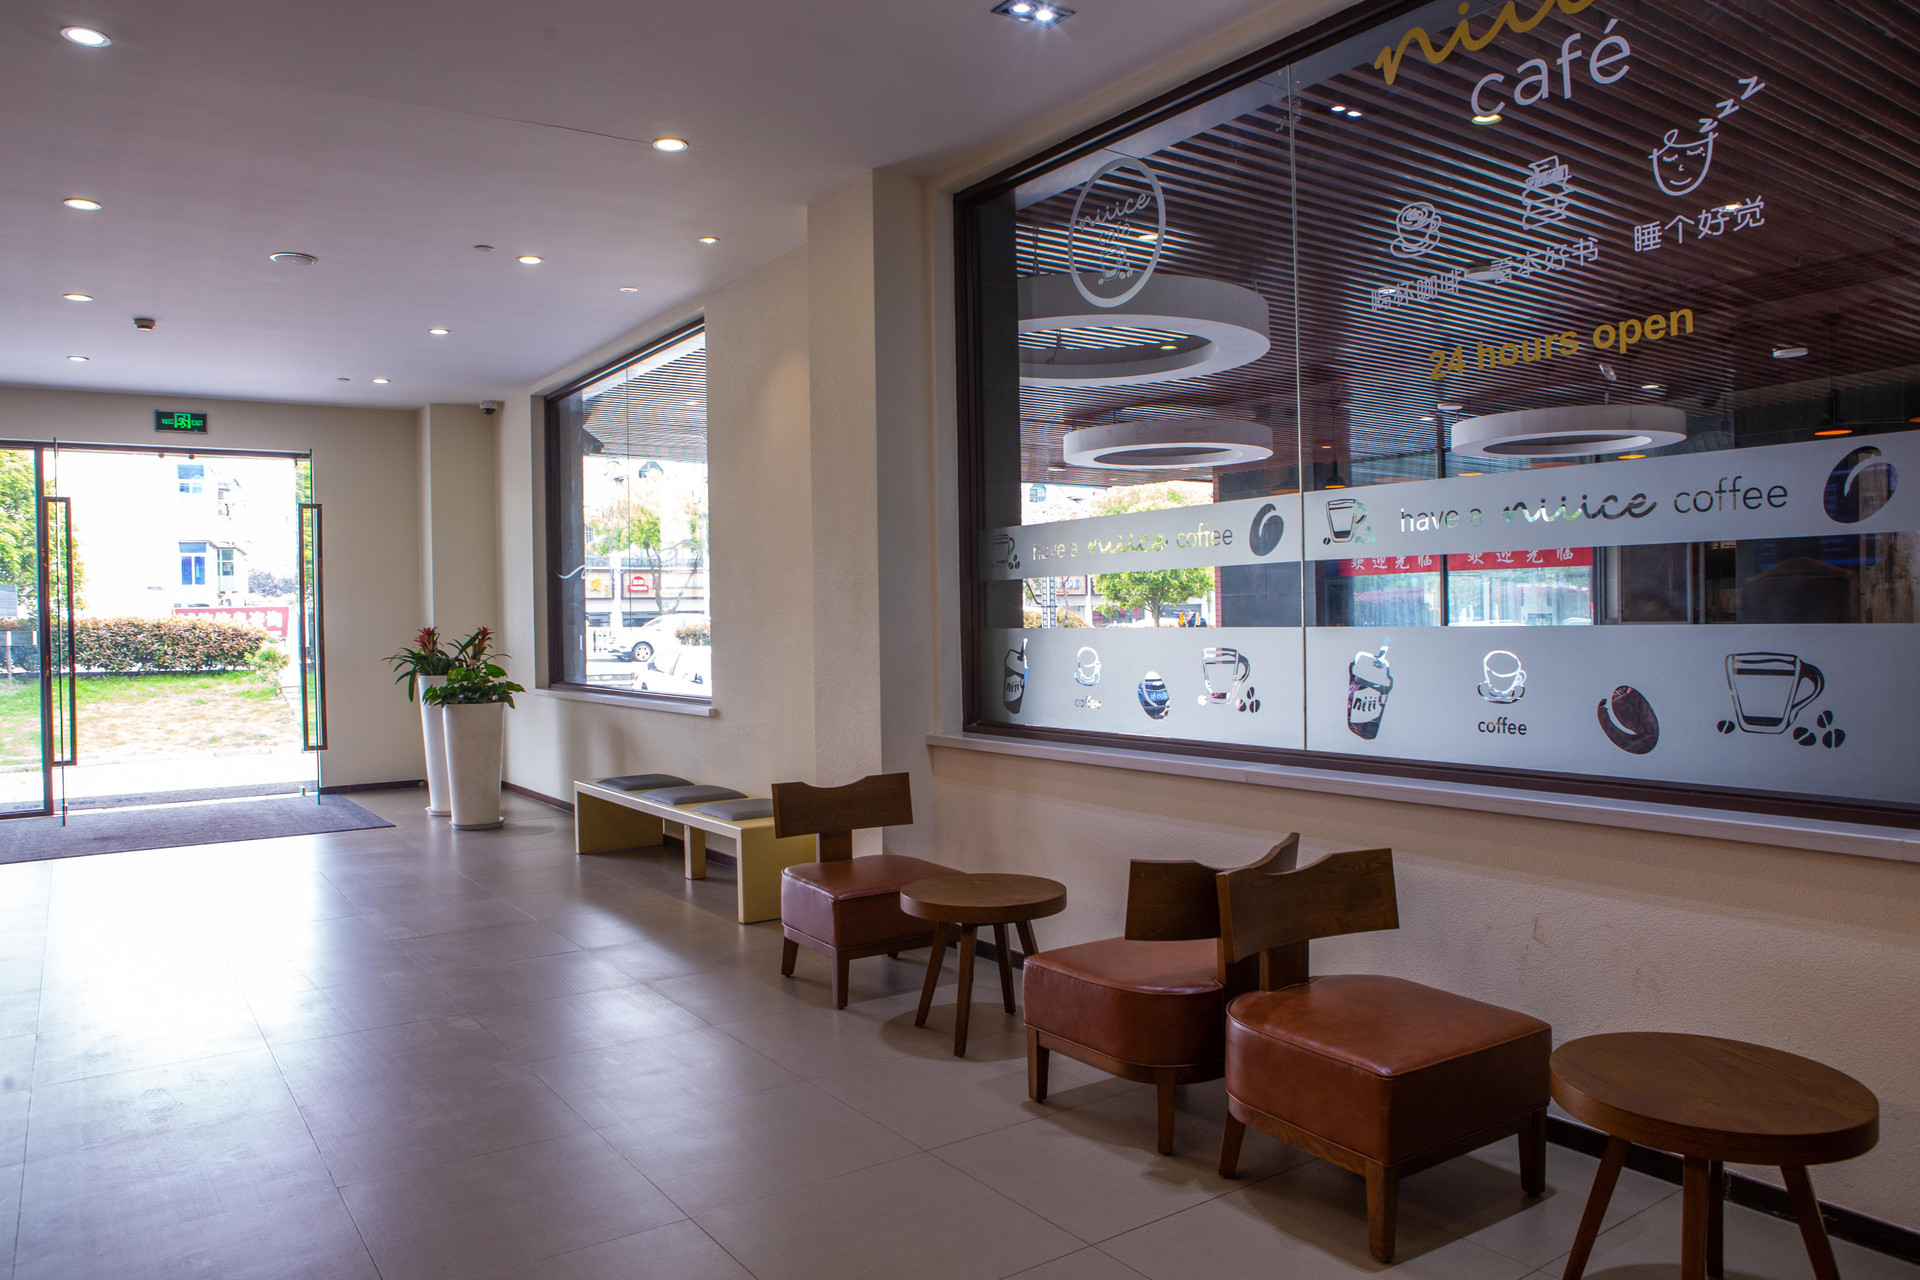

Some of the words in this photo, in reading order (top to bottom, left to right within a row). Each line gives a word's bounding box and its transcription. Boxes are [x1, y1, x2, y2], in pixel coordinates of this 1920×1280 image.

[1470, 18, 1631, 118] café
[1634, 194, 1765, 252] 睡个好觉
[1490, 236, 1599, 285] 看本好书
[1371, 268, 1462, 311] 喝杯咖啡
[1428, 345, 1466, 381] 24
[1477, 330, 1580, 371] hours
[1592, 308, 1694, 355] open
[1401, 507, 1460, 533] have
[1469, 507, 1483, 528] a
[1673, 475, 1789, 515] coffee
[1176, 522, 1233, 549] coffee
[1467, 547, 1574, 565] 欢迎光临
[1350, 554, 1433, 571] 欢迎光临
[1477, 716, 1527, 736] coffee
